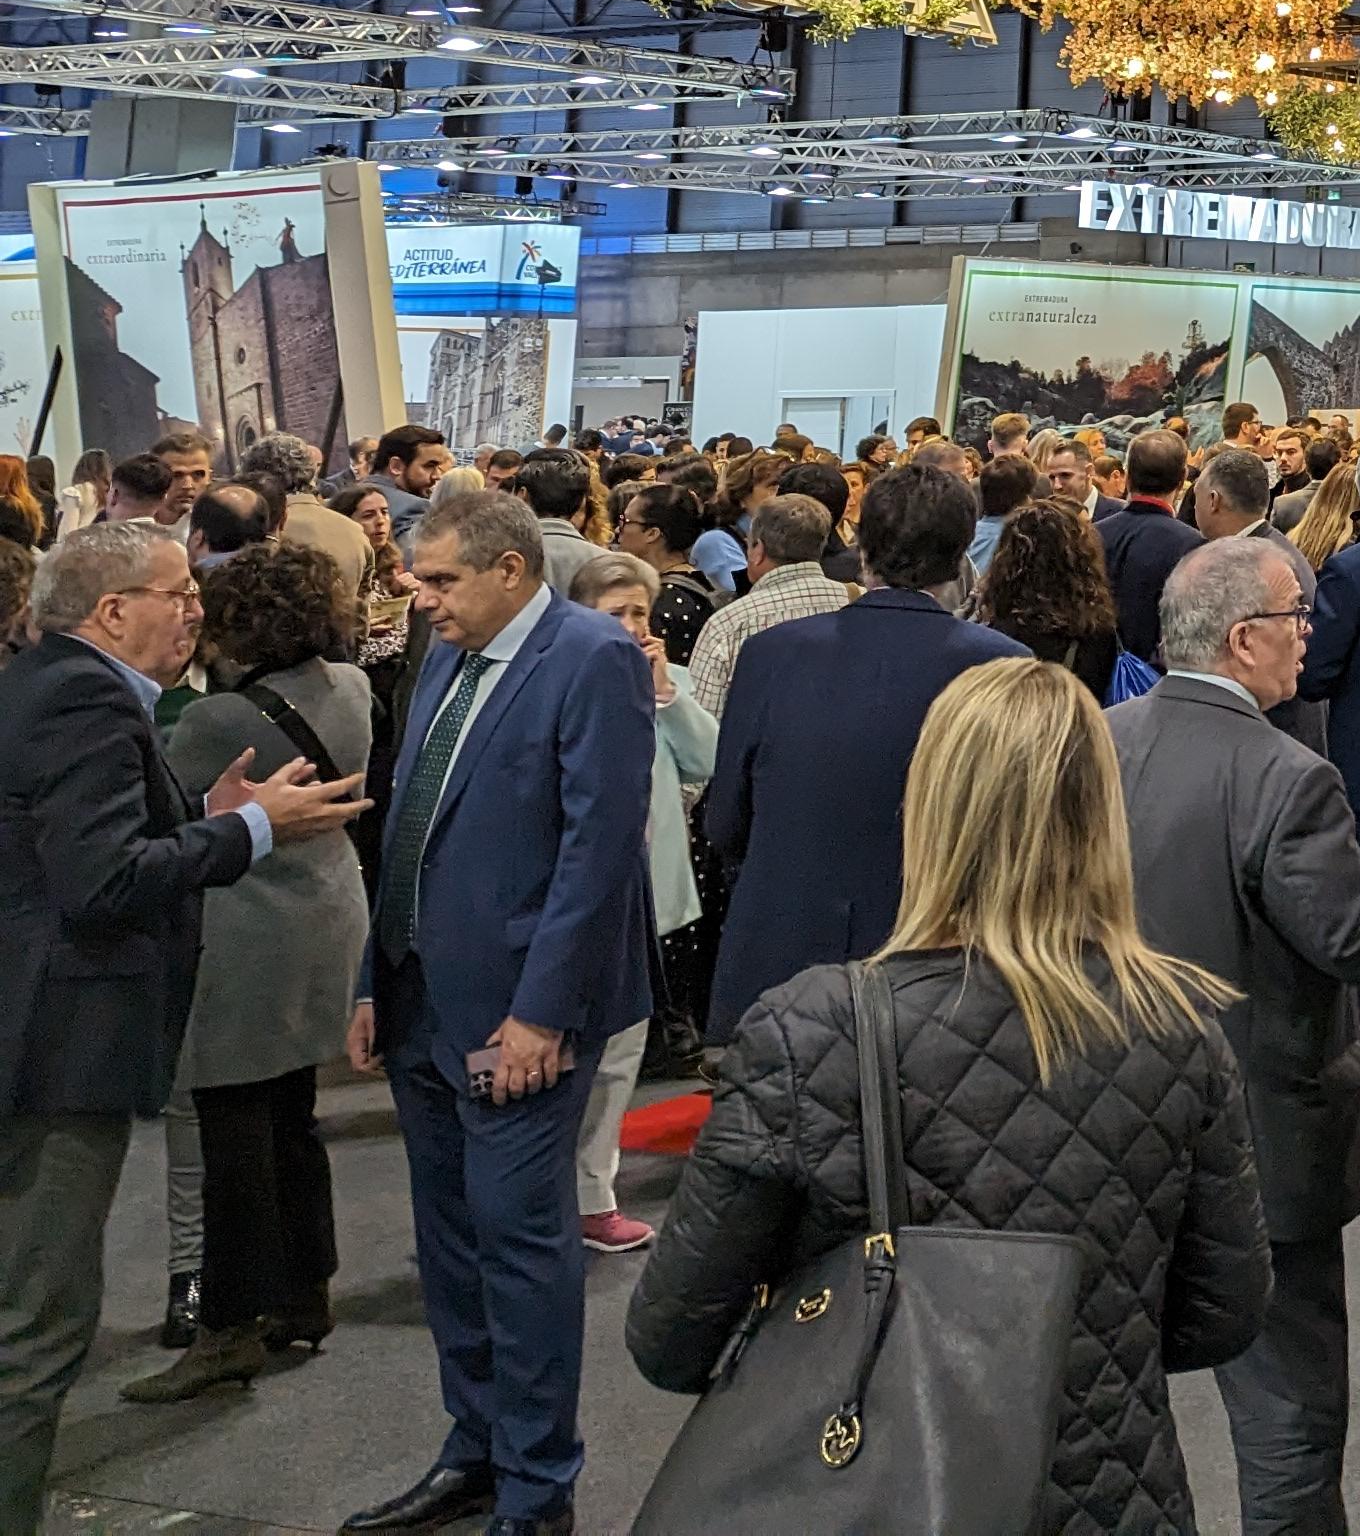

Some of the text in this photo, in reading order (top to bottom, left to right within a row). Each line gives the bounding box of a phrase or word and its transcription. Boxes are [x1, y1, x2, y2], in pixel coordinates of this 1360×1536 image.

[87, 248, 167, 264] extraordinaria
[403, 249, 454, 261] ACTITUD
[391, 258, 486, 279] EDITERRÁNEA
[989, 307, 1097, 324] extranaturaleza
